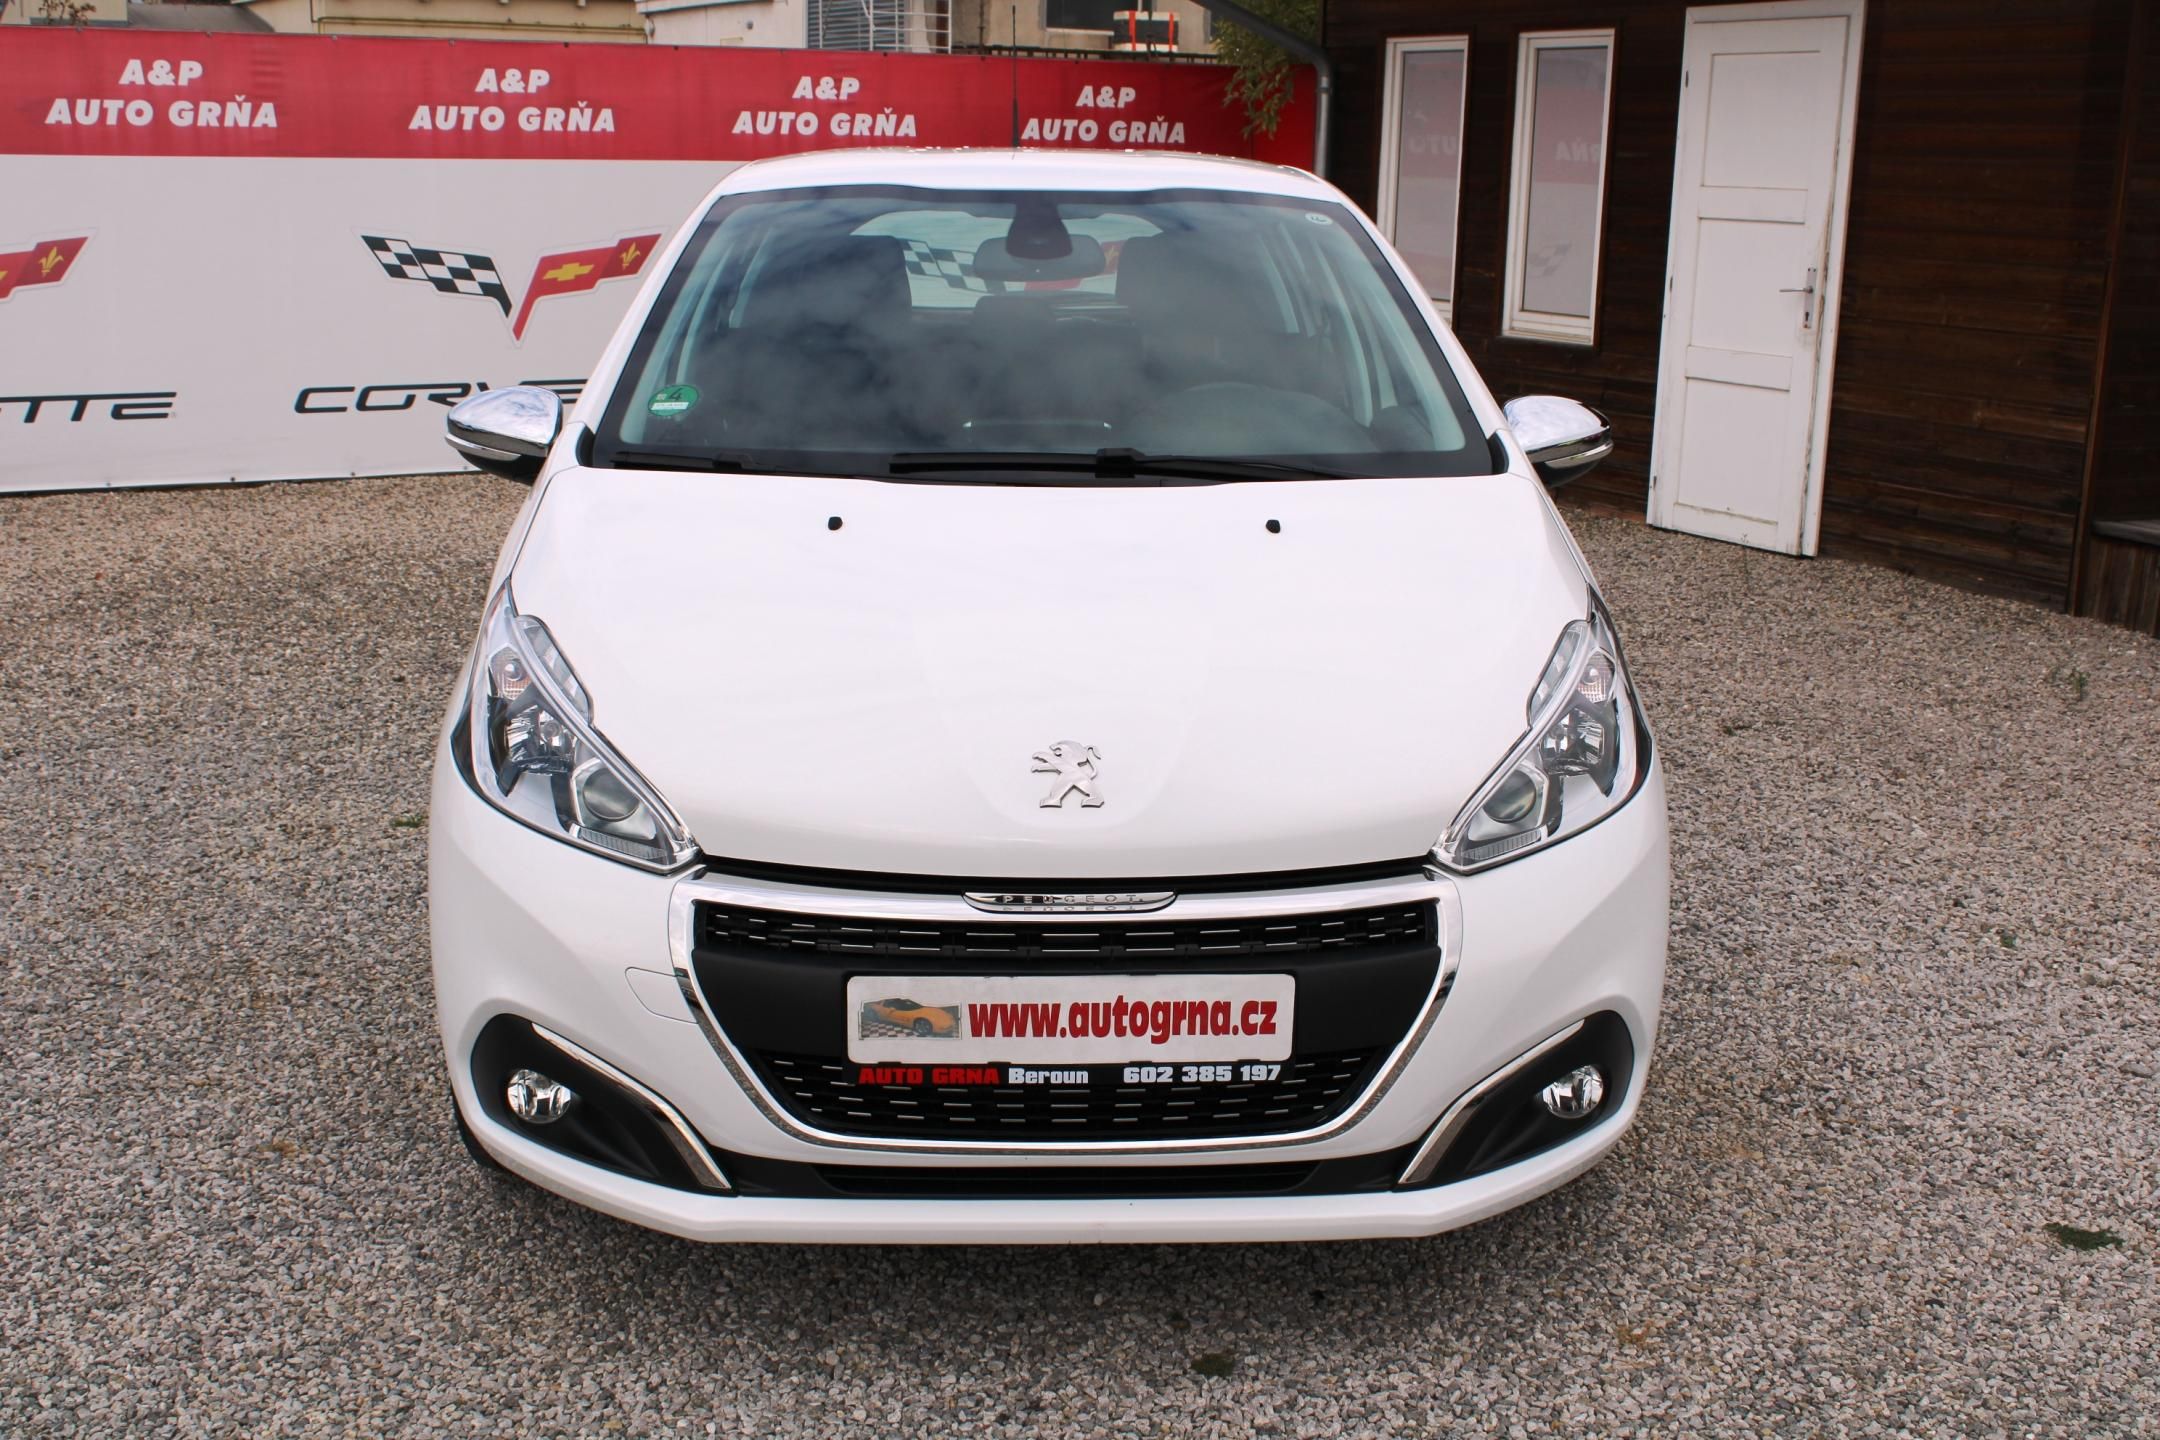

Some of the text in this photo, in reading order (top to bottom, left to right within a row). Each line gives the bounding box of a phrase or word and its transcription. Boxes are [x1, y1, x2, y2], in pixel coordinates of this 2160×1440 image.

[118, 59, 203, 86] A&P
[475, 68, 550, 93] A&P
[792, 76, 860, 100] A&P
[1076, 85, 1136, 108] A&P
[45, 95, 277, 127] AUTO GRŇA
[408, 101, 615, 132] AUTO GRŇA
[732, 107, 917, 137] AUTO GRŇA
[1021, 116, 1185, 144] AUTO GRŇA
[0, 391, 177, 424] TTE
[968, 995, 1277, 1044] www.autogrna.cz
[858, 1064, 1281, 1085] AUTO GRNA Beroun 602 385 197
